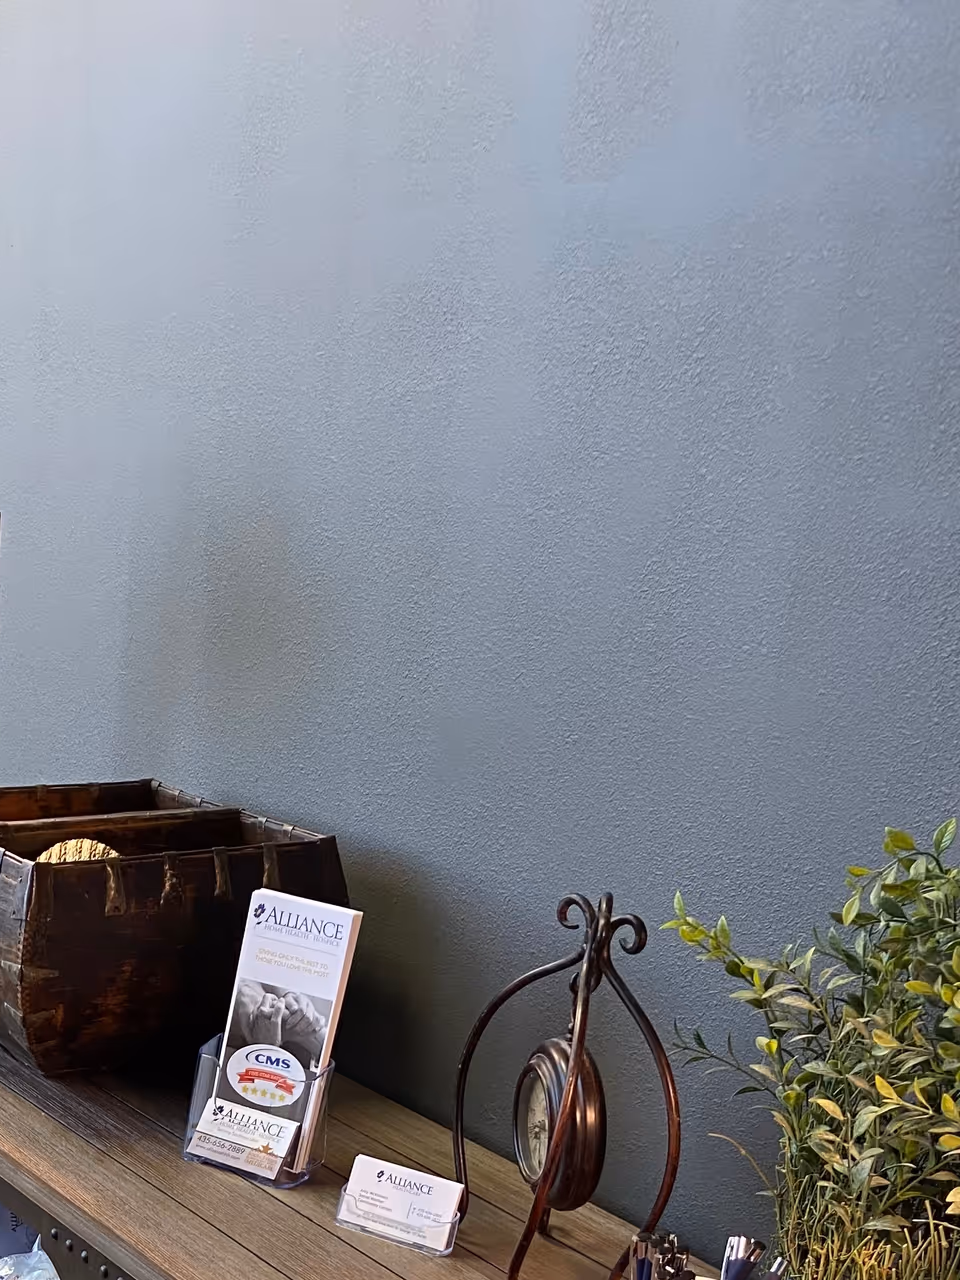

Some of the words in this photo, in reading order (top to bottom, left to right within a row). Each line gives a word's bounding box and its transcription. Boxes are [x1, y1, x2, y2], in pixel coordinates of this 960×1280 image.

[265, 906, 344, 940] ALLIANCE
[264, 924, 286, 934] HOME
[285, 928, 309, 940] HEALTH
[313, 934, 340, 947] HOSPICE
[254, 1053, 291, 1069] CMS
[224, 1108, 288, 1138] ALLIANCE
[197, 1134, 245, 1155] 435-656-2889
[385, 1173, 434, 1196] ALLIANCE
